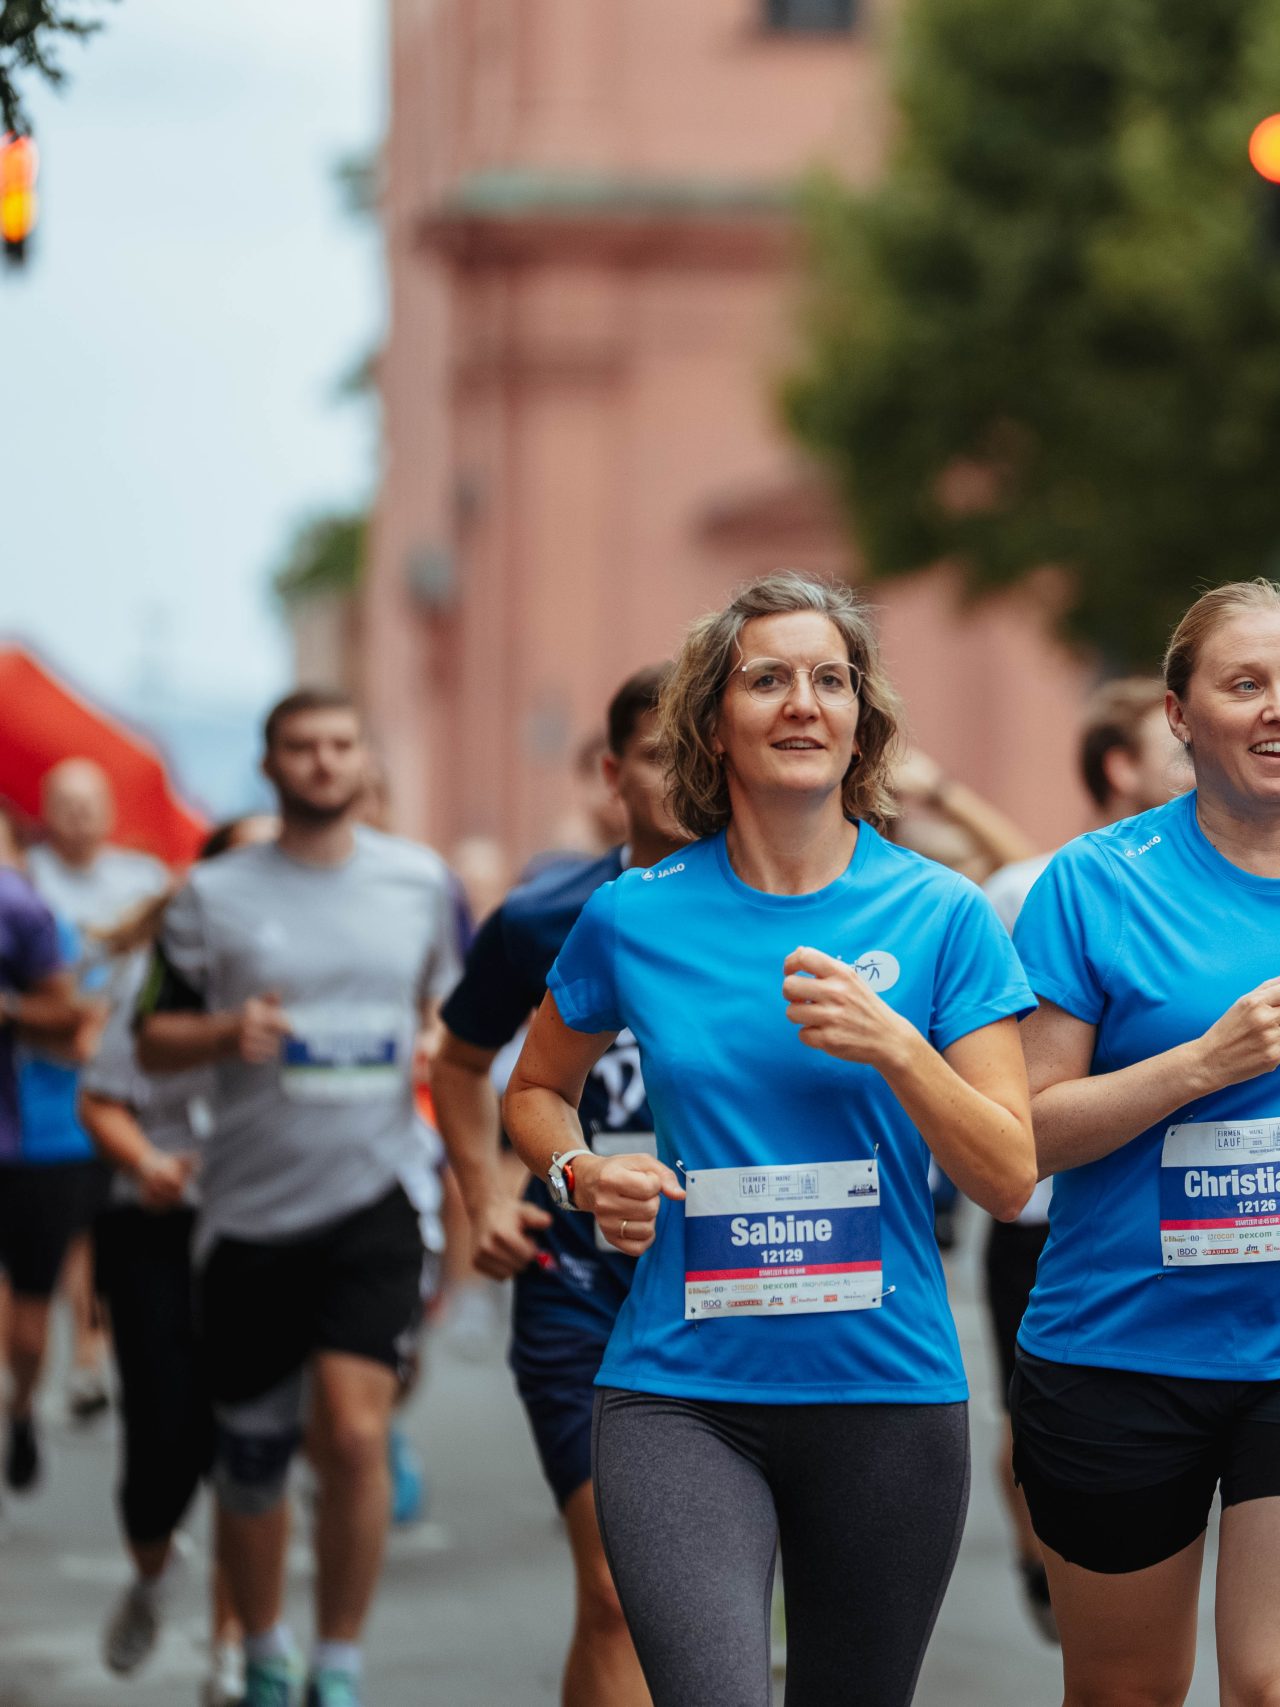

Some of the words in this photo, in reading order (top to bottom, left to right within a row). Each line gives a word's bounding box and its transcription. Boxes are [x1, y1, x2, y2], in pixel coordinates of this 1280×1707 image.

[657, 863, 685, 879] JAKO
[1217, 1129, 1241, 1137] FIRMEN
[1218, 1137, 1241, 1148] LAUF
[742, 1176, 766, 1184] FIRMEN
[742, 1184, 766, 1194] LAUF
[1237, 1199, 1277, 1214] 12126
[730, 1215, 832, 1246] Sabine
[761, 1248, 804, 1264] 12129
[703, 1300, 722, 1308] BDO
